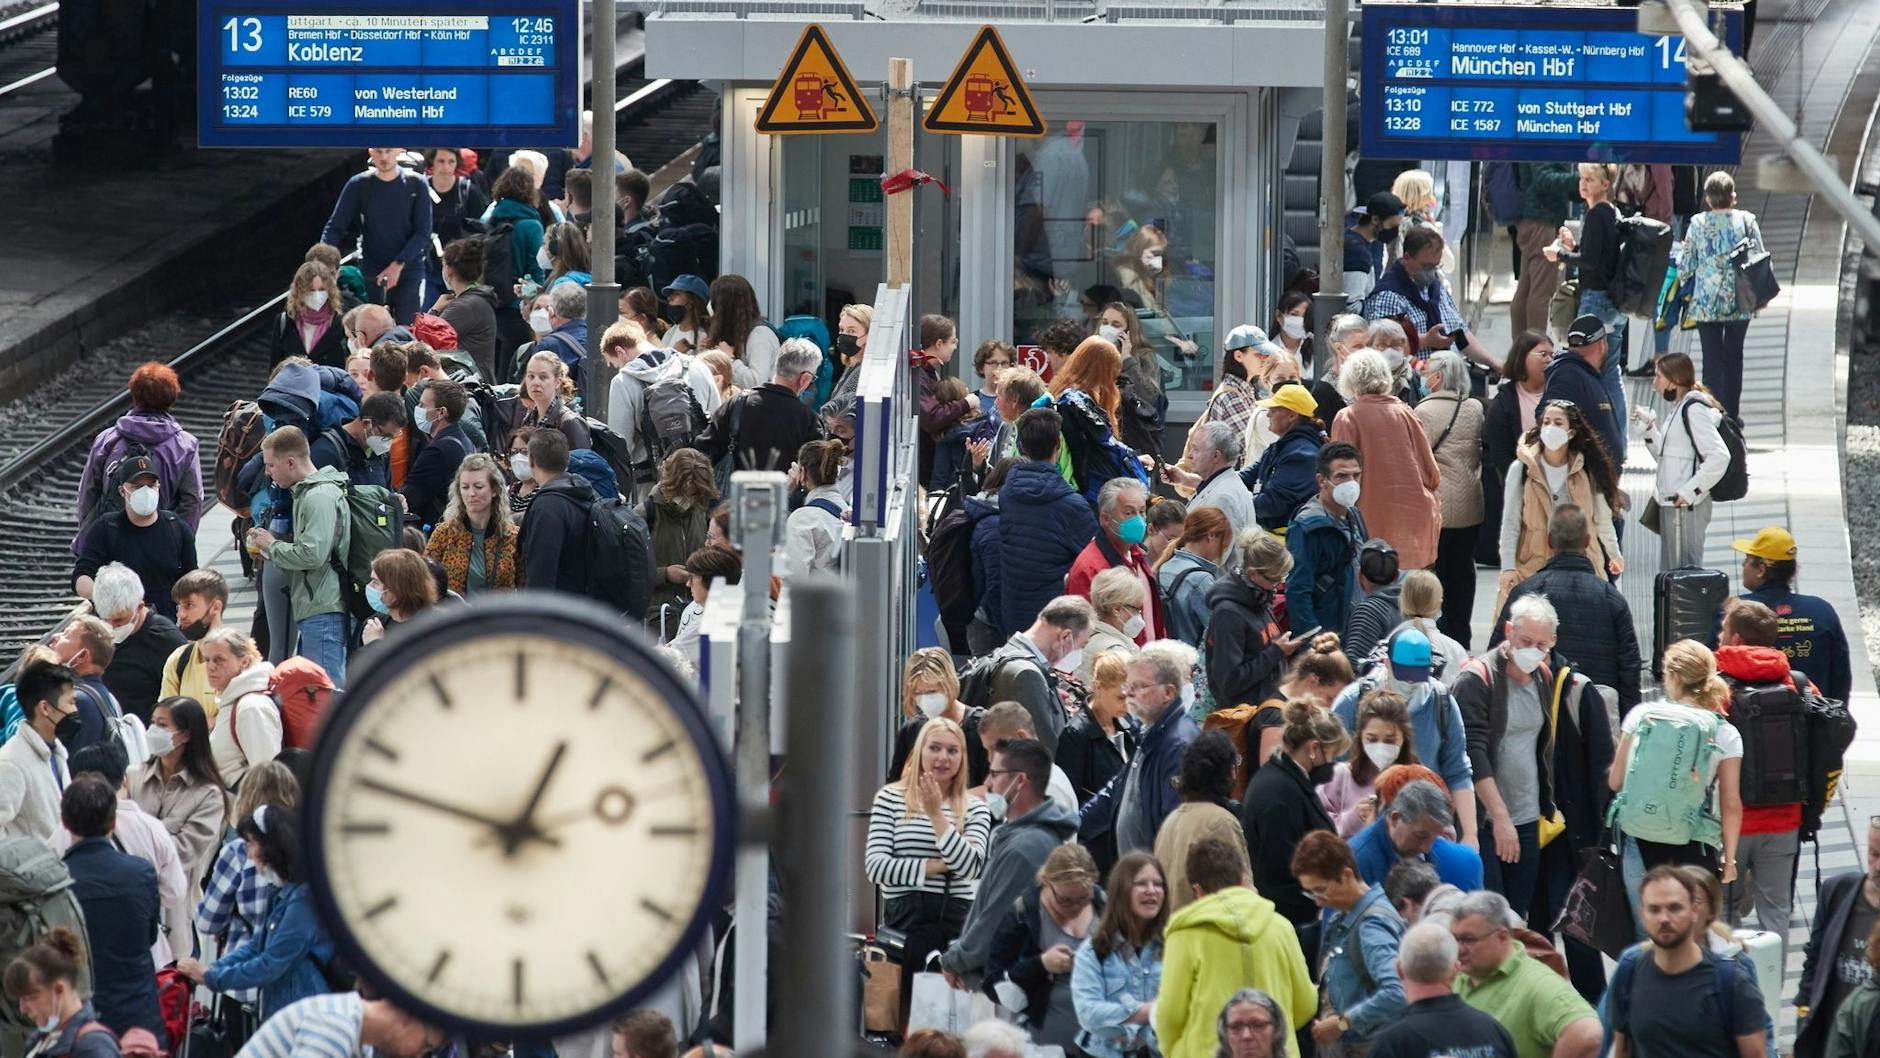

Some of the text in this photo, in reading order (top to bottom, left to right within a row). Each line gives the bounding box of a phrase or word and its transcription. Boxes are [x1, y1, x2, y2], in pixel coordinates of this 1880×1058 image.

[346, 18, 361, 26] ca.
[367, 17, 377, 26] 10
[381, 17, 427, 26] Minuten
[511, 17, 553, 33] 12:46
[223, 17, 263, 52] 13
[288, 30, 322, 40] Bremen
[325, 30, 342, 40] Hbf
[350, 30, 403, 40] Düsseldorf
[405, 30, 421, 40] Hbf
[431, 30, 452, 40] Köln
[455, 30, 471, 40] Hbf
[519, 35, 553, 45] IC 2311
[1388, 29, 1428, 45] 13:01
[288, 42, 363, 62] Koblenz
[1386, 46, 1421, 56] ICE 689
[1452, 43, 1497, 53] Hannover
[1499, 43, 1516, 53] Hbf
[1525, 44, 1575, 55] Kassel-W.
[1583, 45, 1627, 58] Nürnberg
[1629, 46, 1645, 57] Hbf
[1451, 55, 1575, 77] München Hbf
[221, 73, 263, 83] Folgezüge
[223, 86, 259, 100] 13:02
[288, 87, 318, 99] RE60
[355, 86, 457, 100] von Westerland
[1384, 85, 1426, 95] Folgezüge
[223, 104, 259, 118] 13:24
[288, 105, 332, 117] ICE 579
[354, 105, 445, 119] Mannheim Hbf
[1385, 98, 1421, 112] 13:10
[1451, 100, 1495, 113] ICE 772
[1517, 101, 1632, 116] von Stuttgart Hbf
[1385, 116, 1421, 130] 13:28
[1450, 119, 1501, 131] ICE 1587
[1517, 119, 1601, 134] München Hbf
